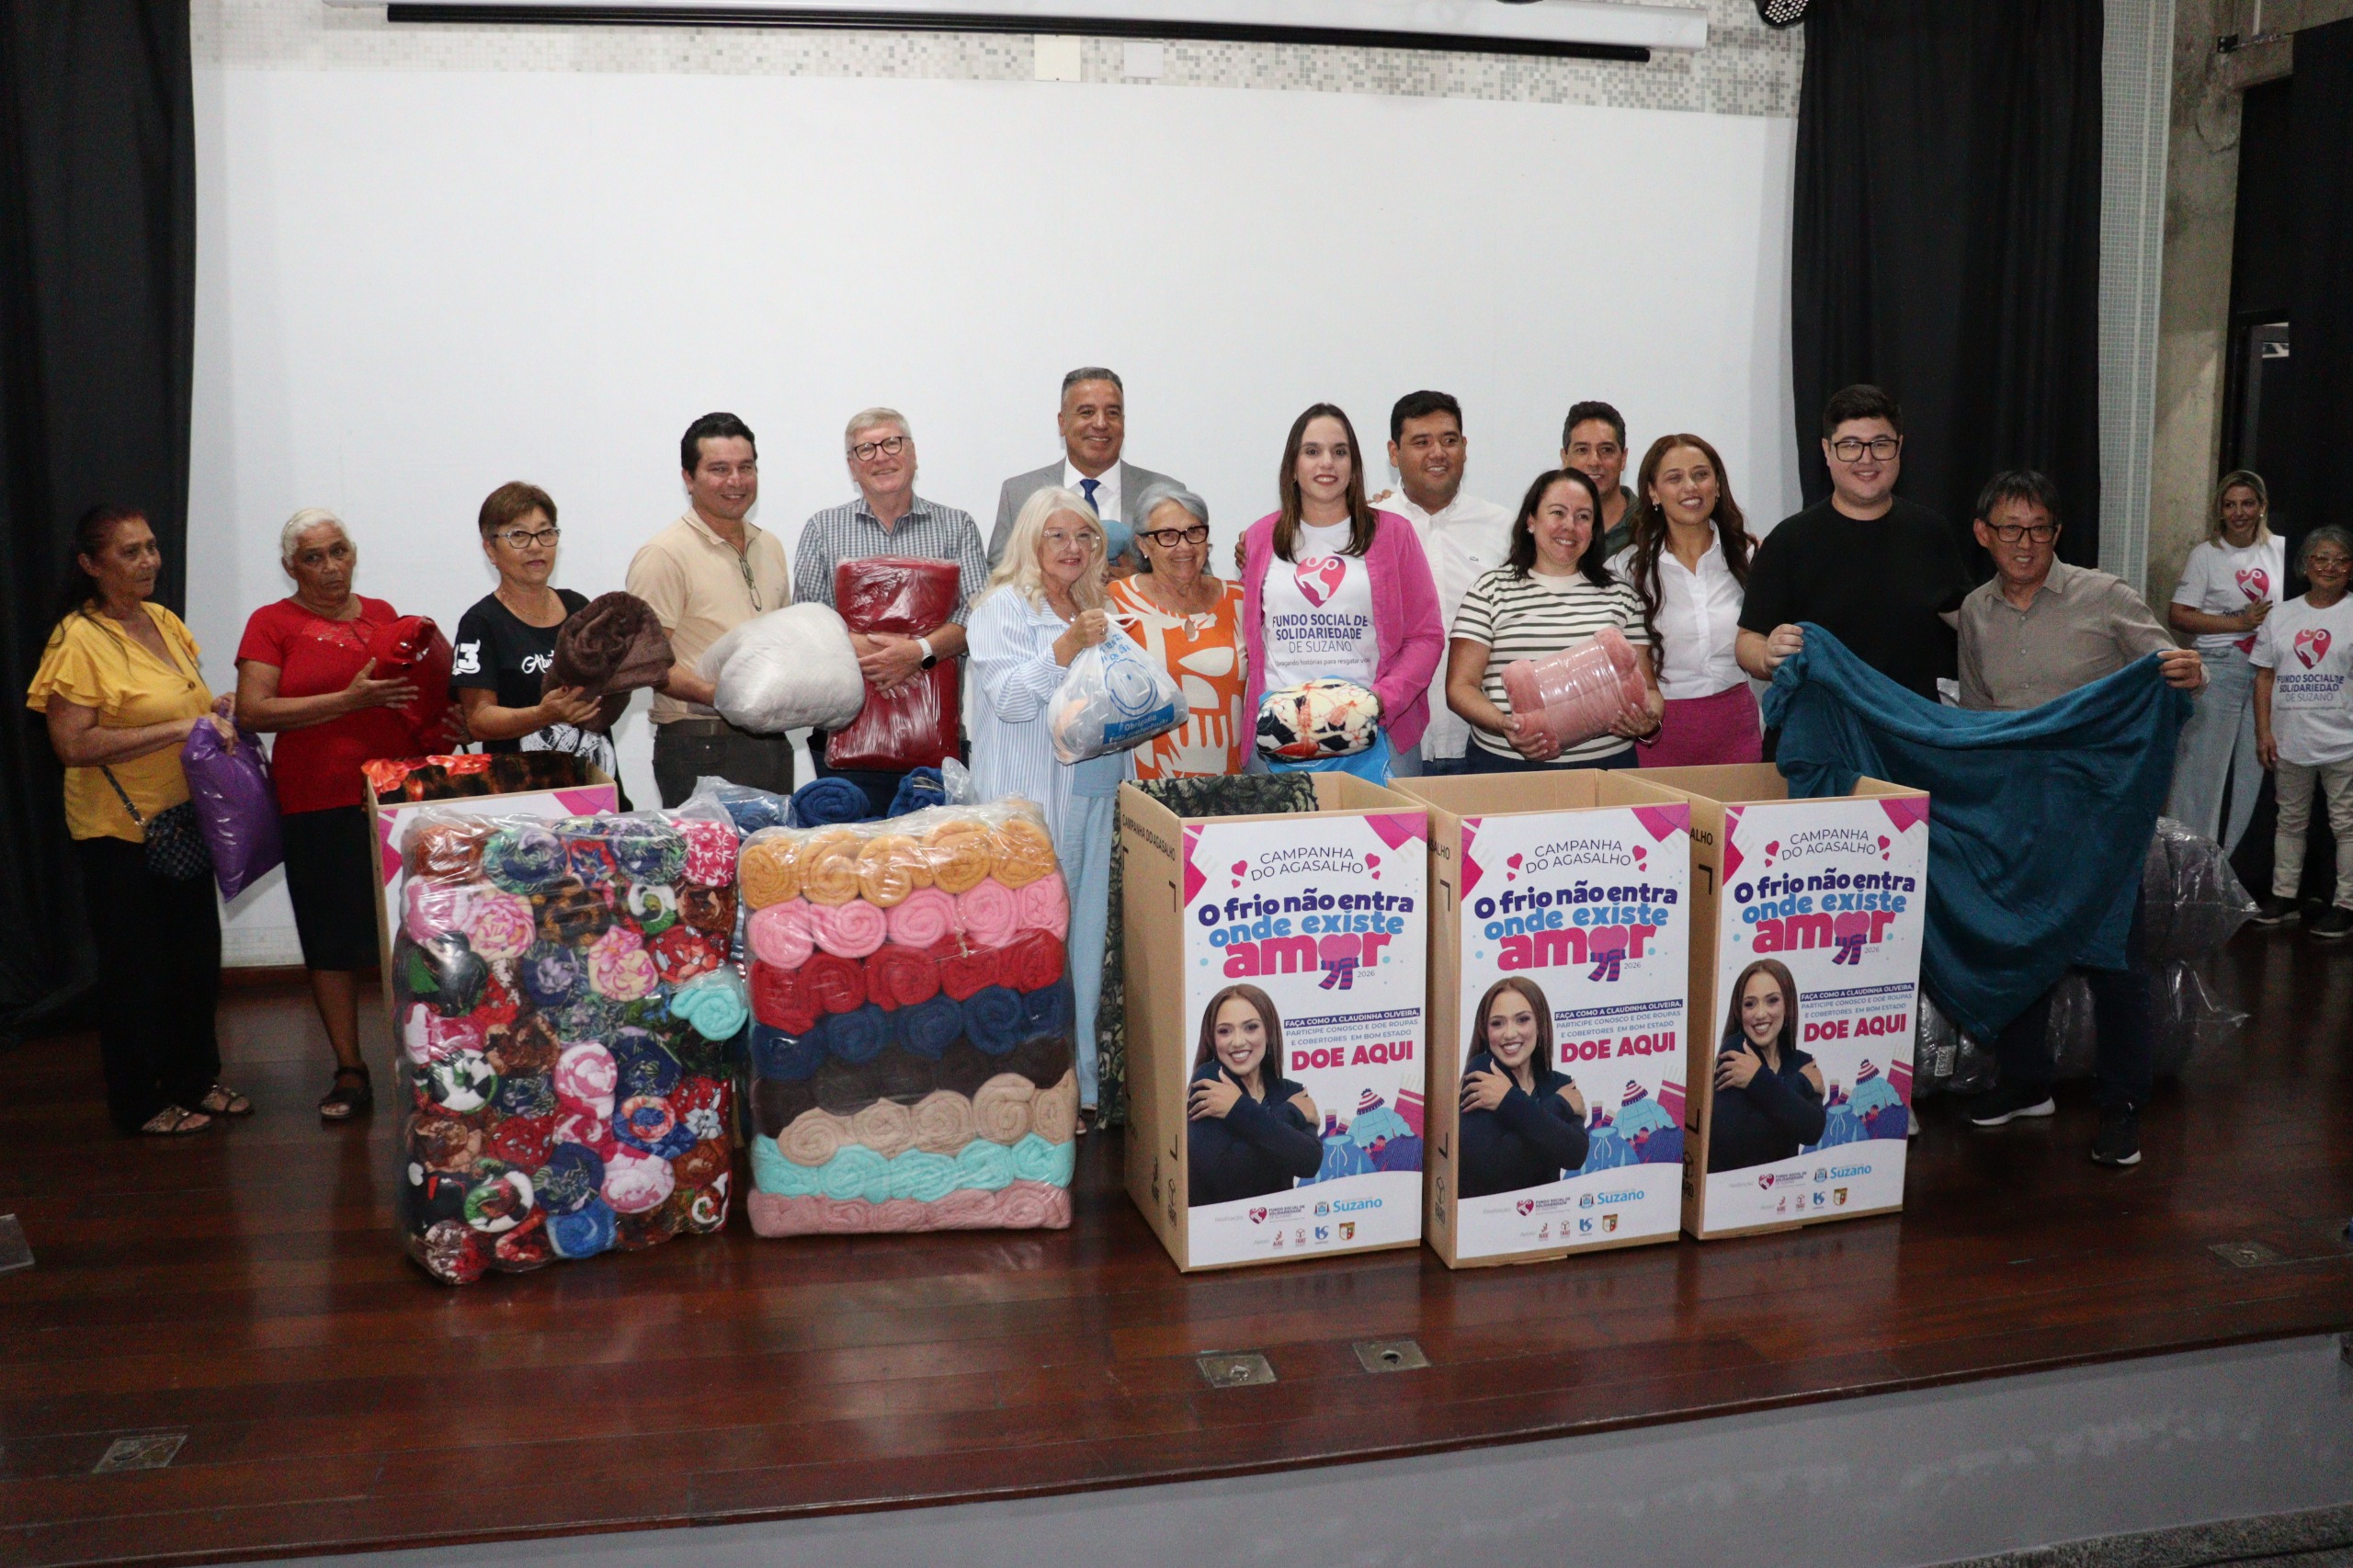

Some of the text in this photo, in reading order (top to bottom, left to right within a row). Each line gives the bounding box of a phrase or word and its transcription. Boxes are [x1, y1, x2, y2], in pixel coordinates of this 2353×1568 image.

[1273, 614, 1368, 627] FUNDO SOCIAL DE
[1276, 628, 1362, 641] SOLIDARIEDADE
[1289, 641, 1352, 653] DE SUZANO
[2277, 675, 2301, 684] FUNDO
[2302, 675, 2334, 683] SOCIAL
[2279, 684, 2339, 692] SOLIDARIEDAD
[2286, 693, 2334, 702] DE SUZANO
[1122, 814, 1175, 861] CAMPANHA DO AGASALHO
[1689, 827, 1713, 846] ALHO
[1790, 829, 1869, 845] CAMPANHA
[1260, 846, 1353, 864] CAMPANHA
[1534, 839, 1622, 858] CAMPANHA
[1782, 842, 1876, 860] DO AGASALHO
[1251, 859, 1363, 881] DO AGASALHO
[1526, 852, 1631, 874] DO AGASALHO
[1734, 868, 1915, 903] O frio não entra
[1199, 887, 1414, 926] O frio não entra
[1474, 880, 1677, 919] O frio não entra
[1742, 890, 1906, 924] onde existe
[1210, 910, 1404, 948] onde existe
[1484, 902, 1669, 940] onde existe
[1752, 910, 1896, 954] amor
[1223, 932, 1392, 979] amor
[1497, 924, 1657, 971] amor
[1357, 970, 1375, 978] 2026
[1624, 961, 1642, 970] 2026
[1847, 987, 1882, 995] CLAUDINHA
[1338, 1013, 1382, 1022] CLAUDINHA
[1383, 1009, 1419, 1018] OLIVEIRA,
[1555, 1012, 1574, 1020] FAÇA
[1576, 1009, 1598, 1017] COMO
[1607, 1005, 1647, 1014] CLAUDINHA
[1648, 1000, 1682, 1009] OLIVEIRA,
[1557, 1020, 1592, 1028] PARTICIPE
[1594, 1017, 1629, 1025] CONOSCO
[1653, 1010, 1680, 1018] ROUPAS
[1811, 1009, 1852, 1017] COBERTORES
[1287, 1028, 1324, 1036] PARTICIPE
[1326, 1025, 1363, 1033] CONOSCO
[1389, 1019, 1418, 1028] ROUPAS
[1567, 1028, 1614, 1038] COBERTORES
[1647, 1020, 1674, 1028] ESTADO
[1804, 1014, 1906, 1042] DOE AQUI
[1298, 1035, 1347, 1045] COBERTORES
[1382, 1029, 1411, 1039] ESTADO
[1292, 1040, 1413, 1071] DOE AQUI
[1561, 1031, 1676, 1062] DOE AQUI
[1830, 1165, 1871, 1179] Suzano
[1334, 1198, 1382, 1213] Suzano
[1597, 1190, 1644, 1204] Suzano
